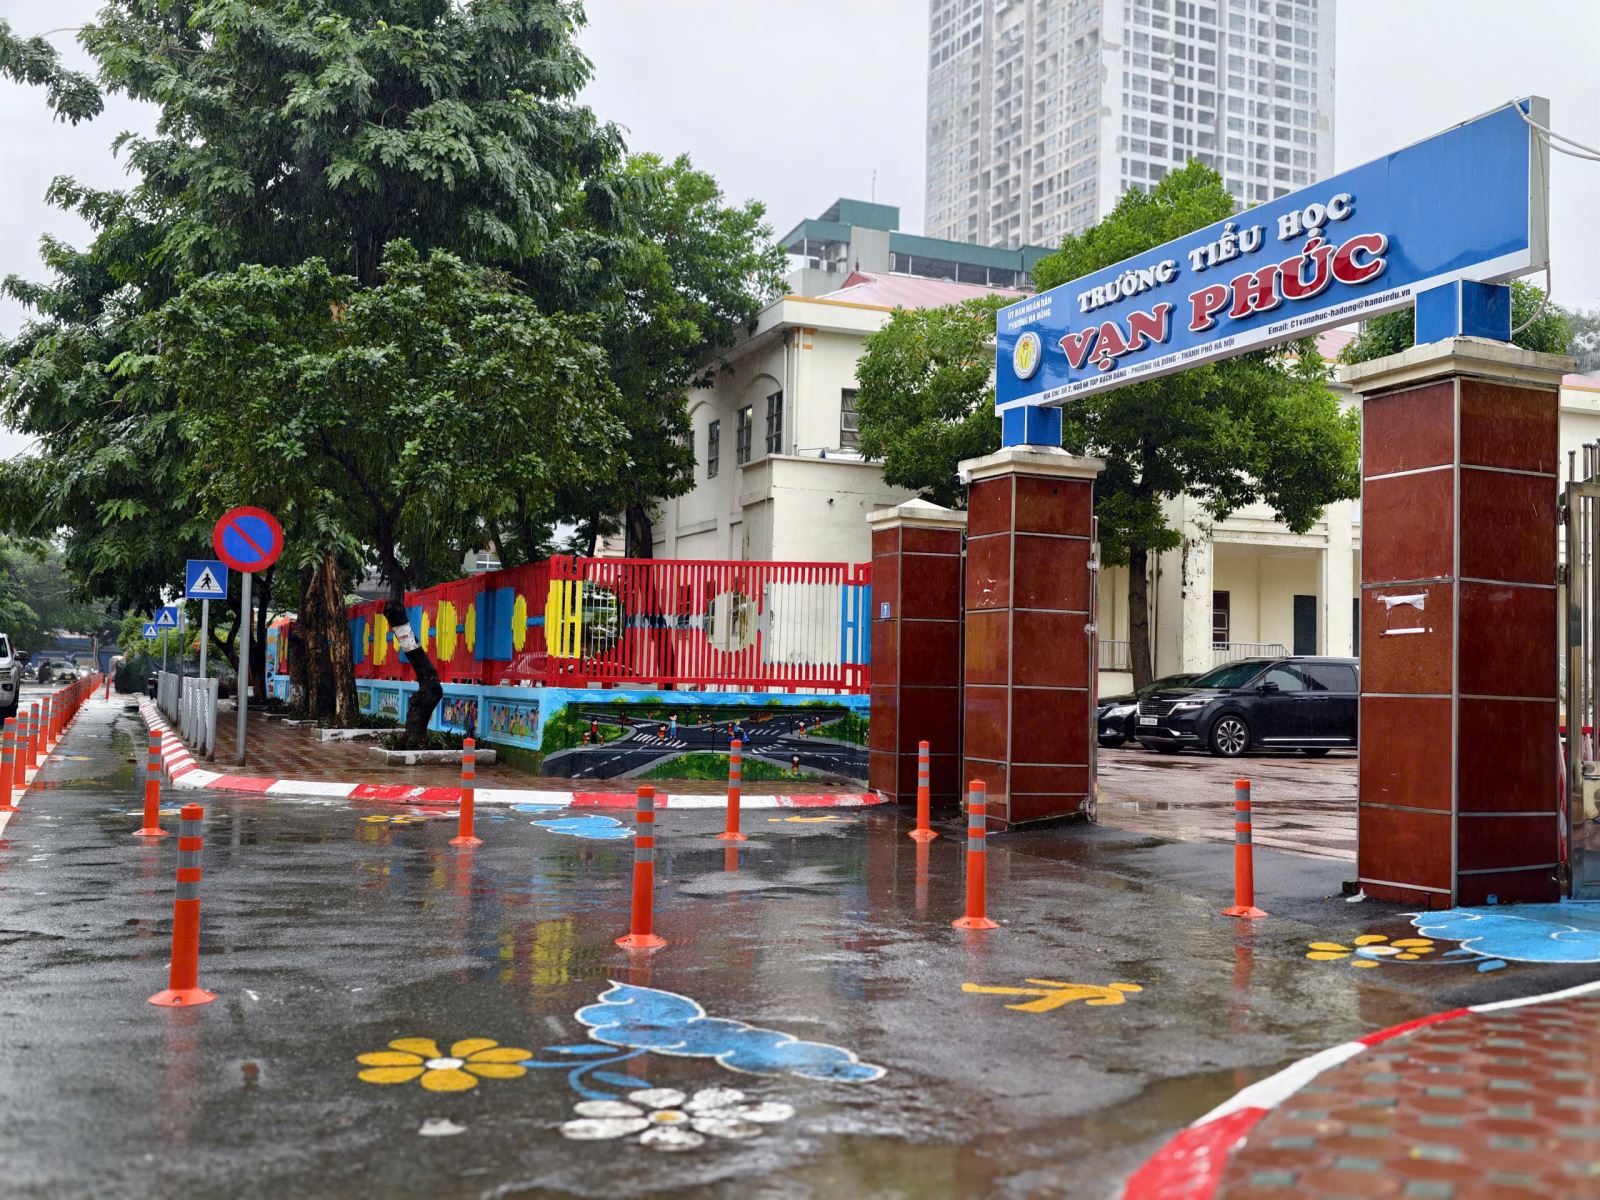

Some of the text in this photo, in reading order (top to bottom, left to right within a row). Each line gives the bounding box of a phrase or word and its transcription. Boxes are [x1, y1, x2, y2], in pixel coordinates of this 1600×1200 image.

[1077, 193, 1355, 313] TRƯỜNG TIỂU HỌC
[1015, 305, 1026, 317] BAN
[1059, 303, 1172, 371] VẠN
[1189, 233, 1389, 332] PHÚC
[1268, 289, 1411, 335] Email: C1vanphuc-hadong@hanoiedu.vn
[1181, 348, 1200, 360] THÀNH
[1201, 343, 1213, 354] PHỐ
[1224, 338, 1235, 348] NỘI
